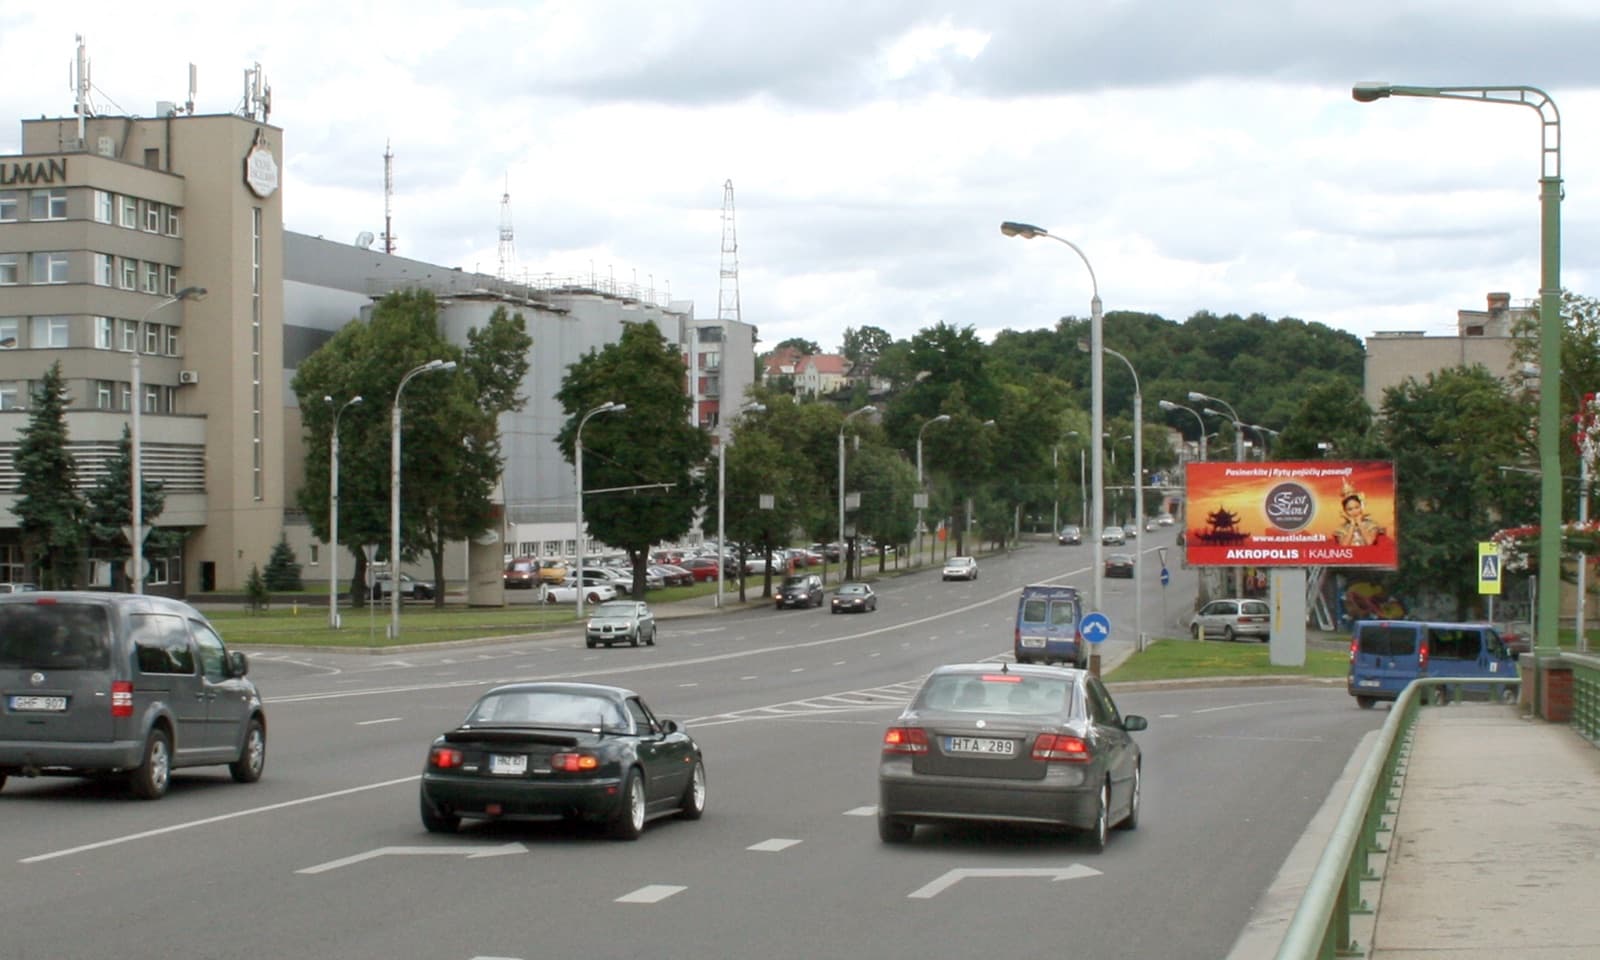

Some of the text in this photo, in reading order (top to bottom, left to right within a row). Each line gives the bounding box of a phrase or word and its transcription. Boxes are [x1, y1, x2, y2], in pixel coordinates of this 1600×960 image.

[1252, 533, 1326, 542] www.eastisland.lt
[1226, 548, 1353, 559] AKROPOLIS KAUNAS
[952, 738, 1013, 753] HTA 289
